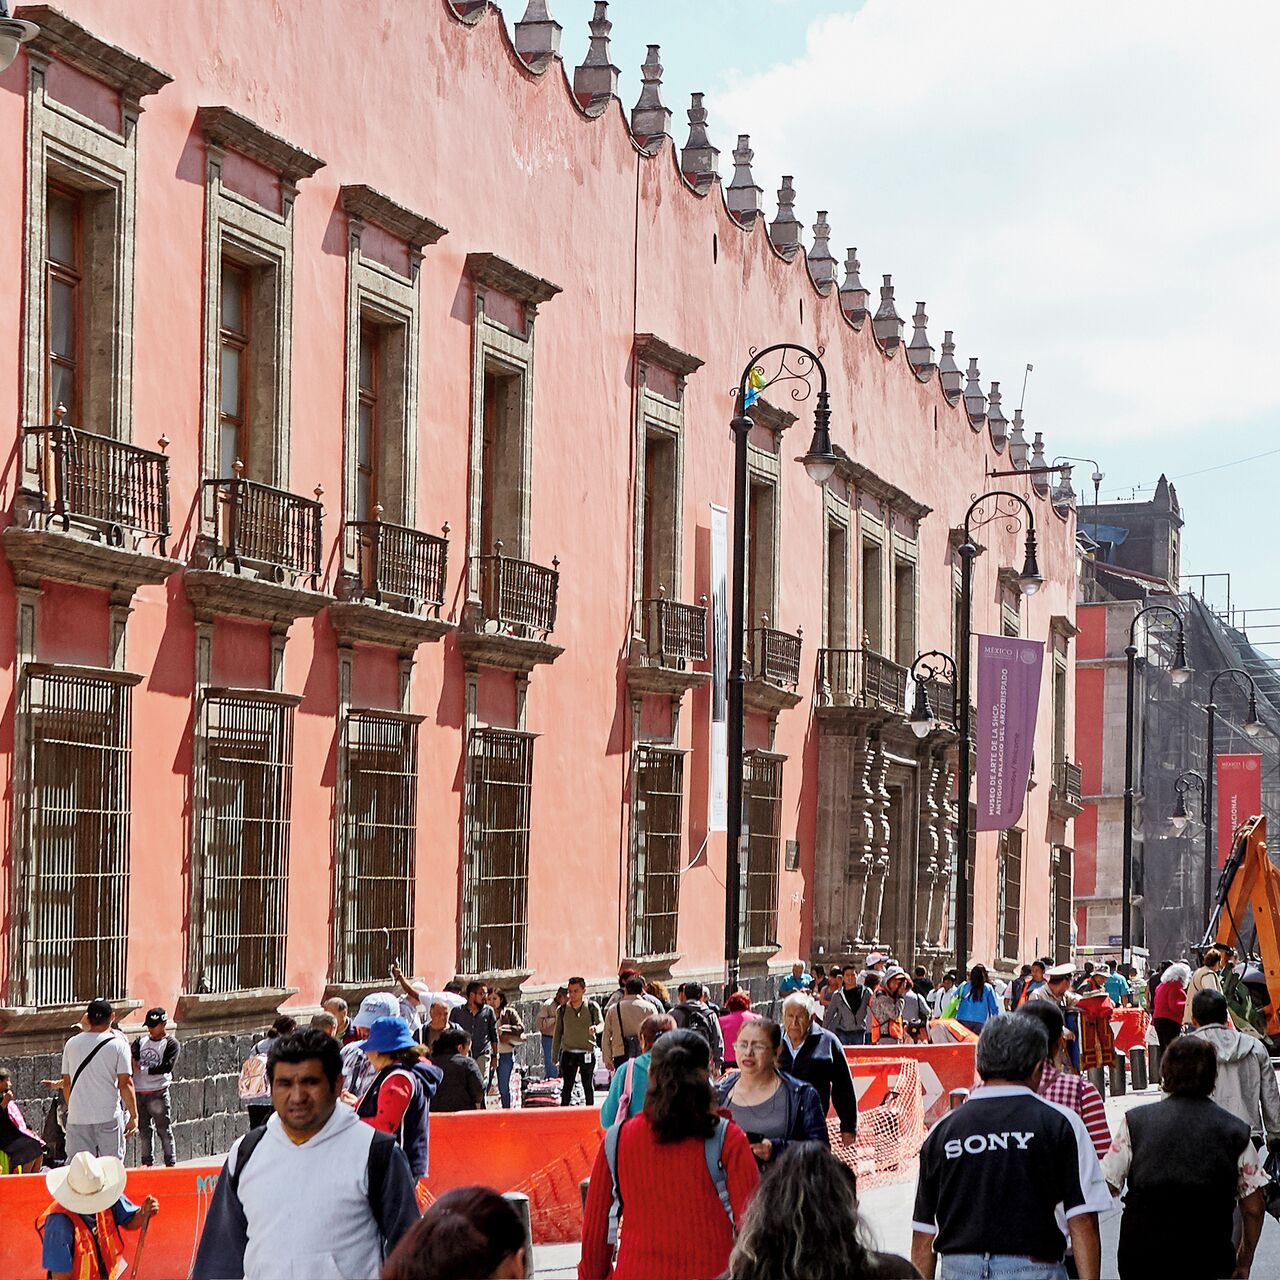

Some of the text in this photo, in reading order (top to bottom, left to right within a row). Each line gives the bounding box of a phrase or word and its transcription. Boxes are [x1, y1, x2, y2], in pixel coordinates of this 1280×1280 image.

[992, 728, 998, 739] LA
[991, 740, 998, 751] DE
[995, 779, 1003, 816] ANTIGUO
[1000, 668, 1008, 725] ARZOBISPADO
[990, 774, 996, 786] DE
[943, 1131, 1035, 1160] SONY
